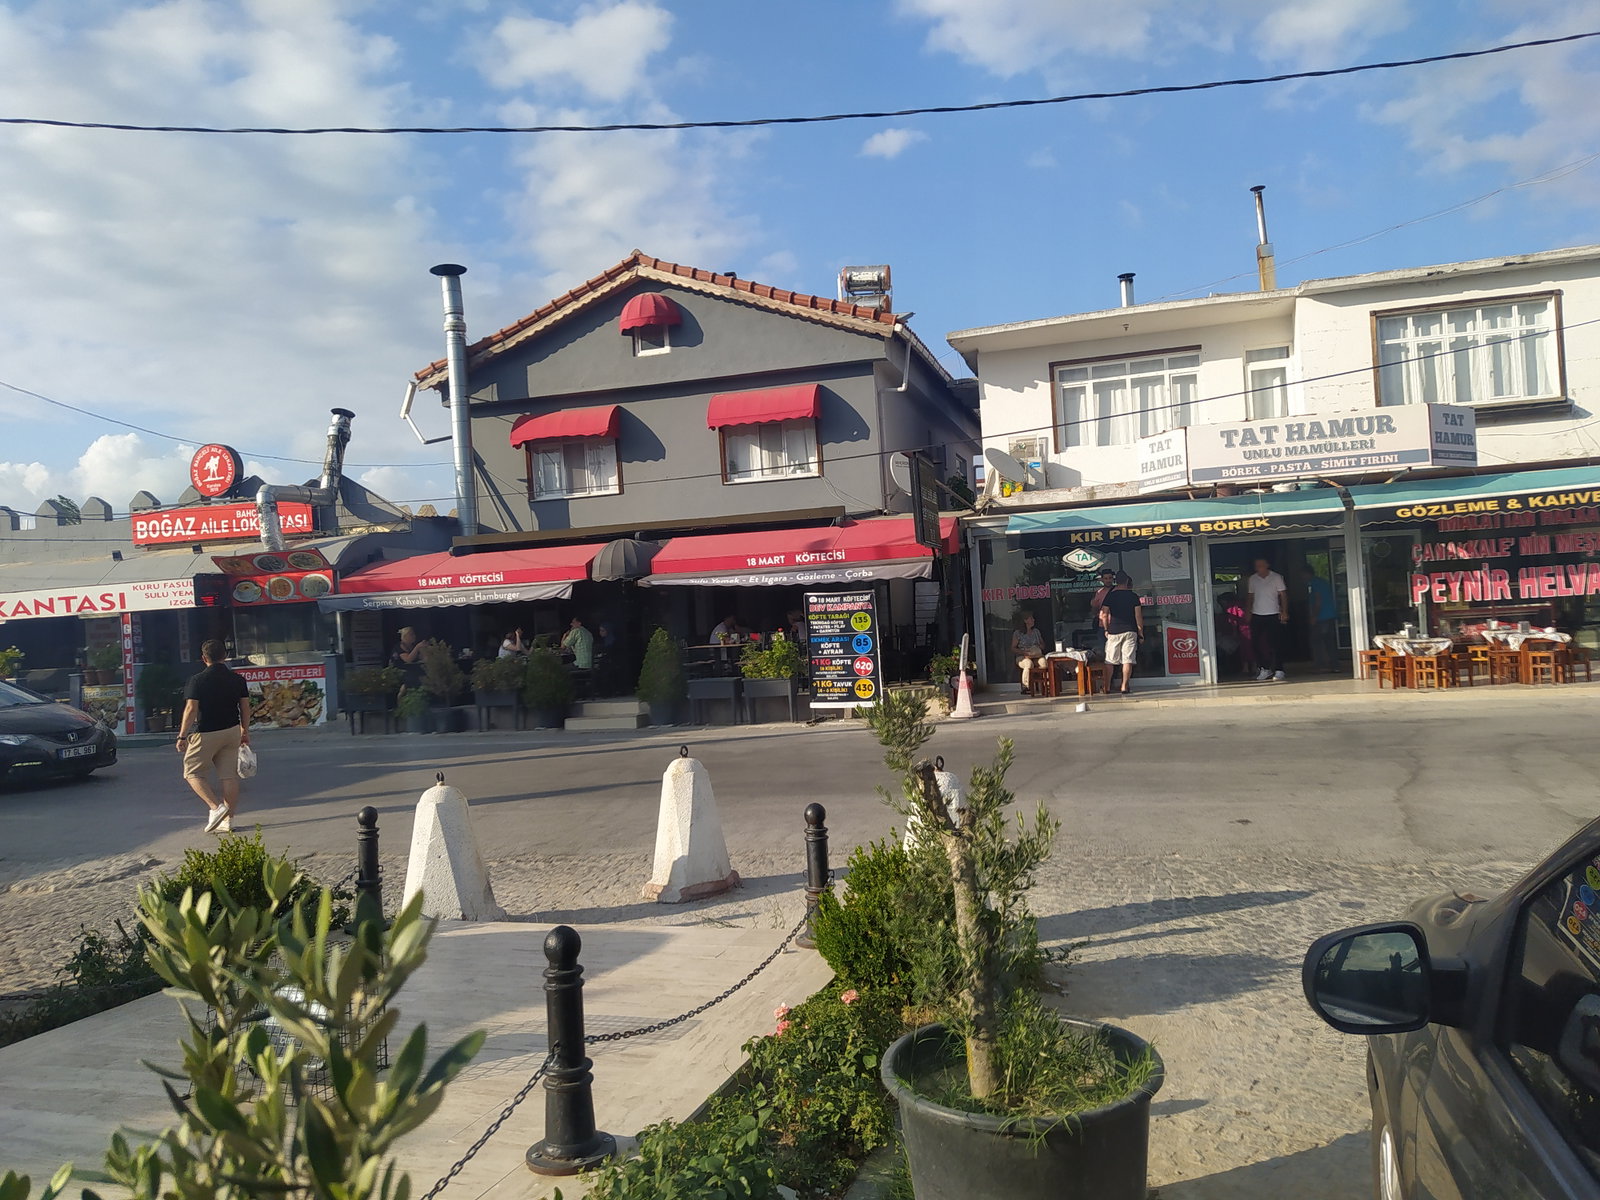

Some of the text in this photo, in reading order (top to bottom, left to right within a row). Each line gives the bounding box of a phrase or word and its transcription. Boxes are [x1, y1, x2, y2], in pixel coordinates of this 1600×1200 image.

[1443, 412, 1464, 427] TAT
[1220, 414, 1397, 448] TAT HAMUR
[1435, 431, 1474, 446] HAMUR
[1149, 438, 1172, 454] TAT
[1243, 438, 1376, 460] UNLU MAMÜLLERİ
[1141, 454, 1183, 473] HAMUR
[1221, 464, 1261, 478] BÖREK
[1270, 461, 1311, 474] PASTA
[1321, 456, 1356, 469] SİMİT
[1358, 453, 1399, 466] FIRINI
[236, 509, 258, 520] BAHÇ
[1396, 500, 1500, 518] GÖZLEME
[1506, 498, 1522, 509] &
[136, 514, 308, 540] BOĞAZ AİLE LOKTASI
[1070, 518, 1271, 544] KIR PİDESİ & BÖREK
[747, 549, 846, 567] 18 MART KÖFTECİSİ
[1075, 552, 1094, 561] TAT
[417, 571, 504, 587] 18 MART KÖFTECİSİ
[762, 574, 787, 585] Izgara
[796, 571, 836, 581] Gözleme
[845, 569, 873, 580] Çorba
[1411, 562, 1512, 604] PEYNİR
[132, 580, 194, 591] KURU FASUL
[982, 588, 1004, 601] KIR
[1007, 581, 1050, 600] PİDESİ
[144, 589, 194, 600] SULU YEM
[363, 598, 393, 609] Serpme
[395, 595, 428, 606] Kahvaltı
[438, 594, 466, 603] Dürüm
[474, 591, 520, 601] Hamburger
[169, 599, 194, 607] IZGA
[854, 616, 868, 624] 135
[856, 638, 869, 646] 85
[123, 623, 135, 722] GÖZLEME
[855, 661, 872, 670] 620
[239, 670, 270, 681] ZGARA
[821, 680, 832, 688] KG
